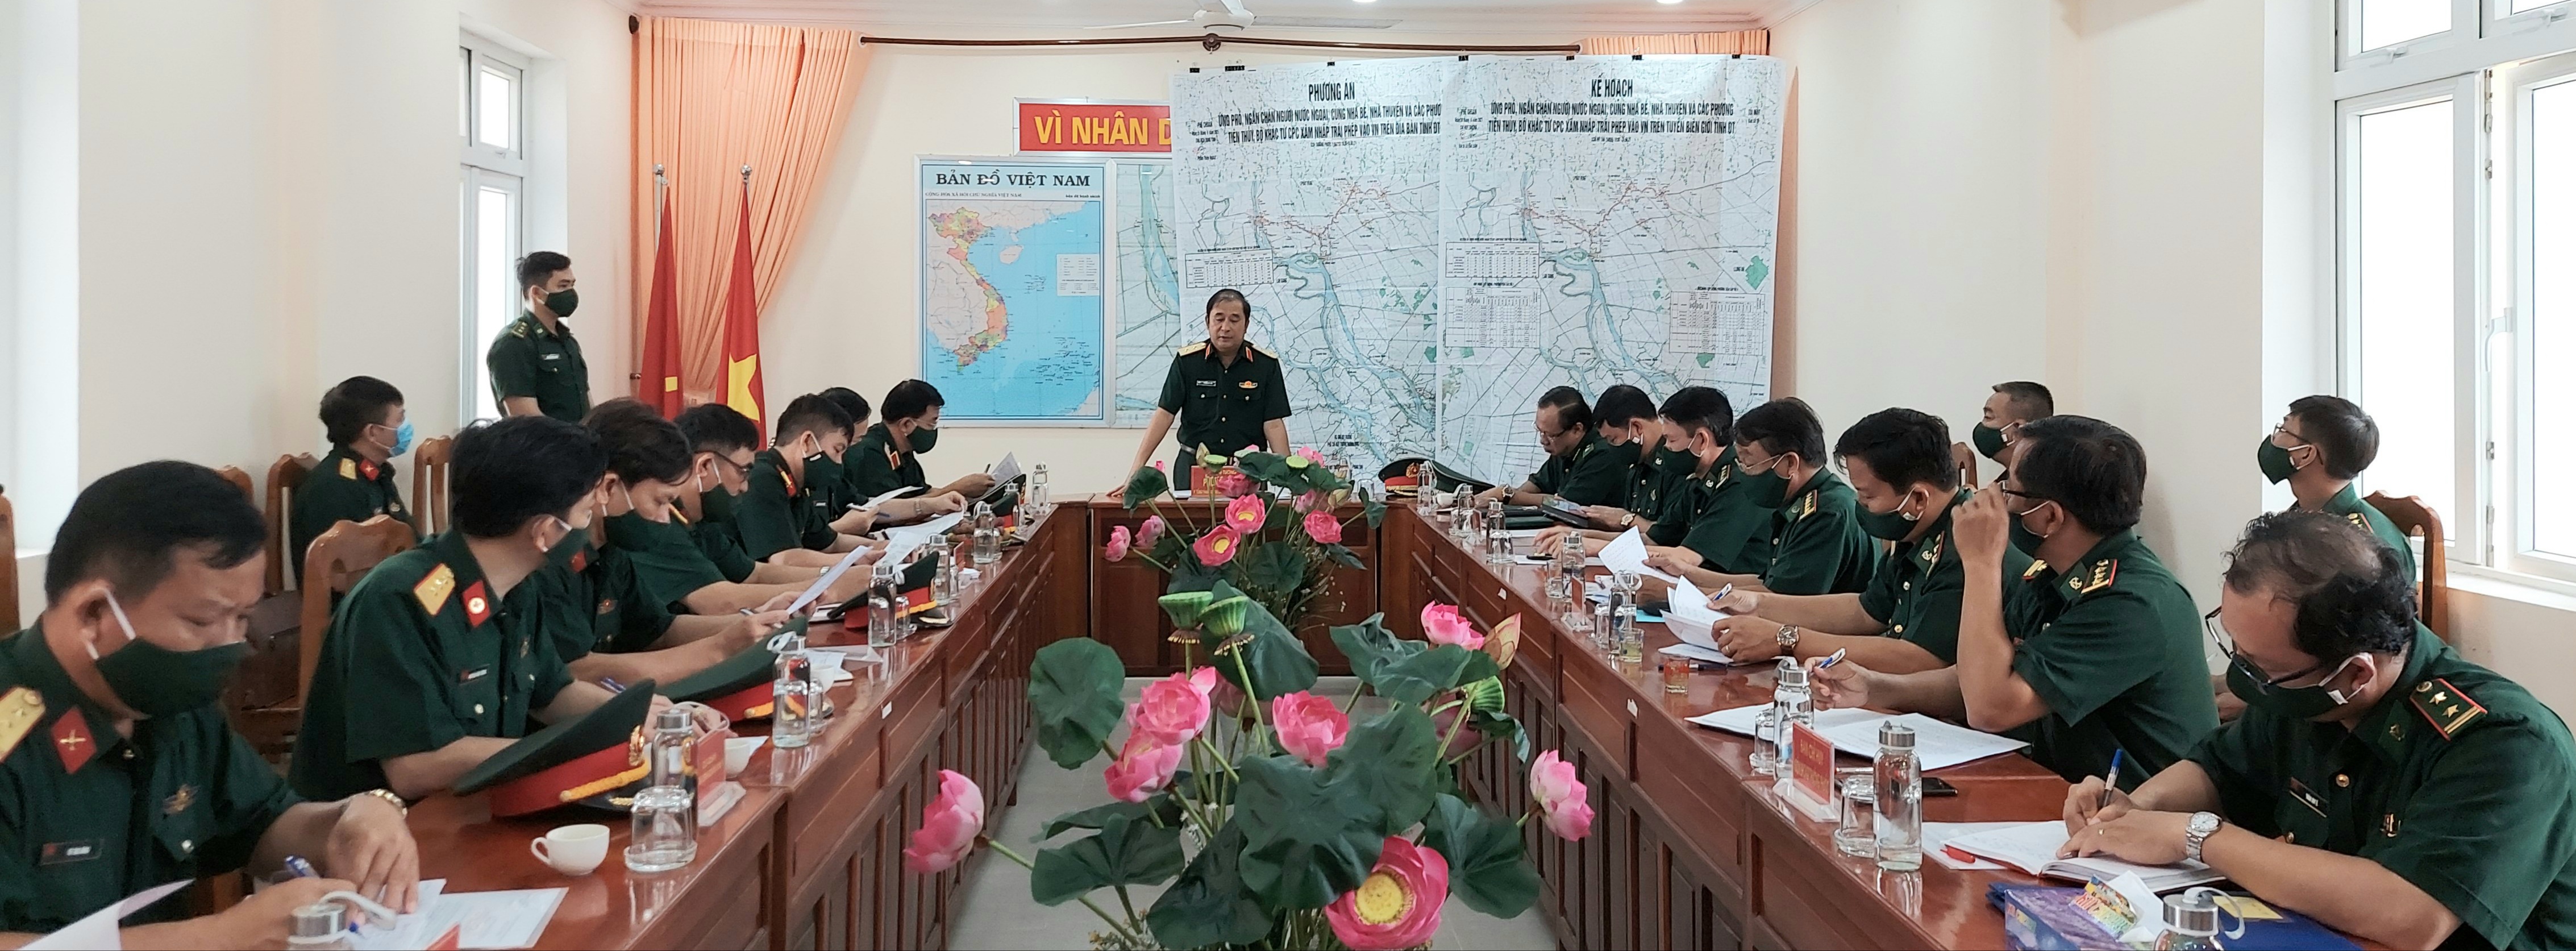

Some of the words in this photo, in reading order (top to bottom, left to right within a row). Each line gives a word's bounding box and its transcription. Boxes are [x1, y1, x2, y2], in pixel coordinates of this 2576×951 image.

[1308, 81, 1341, 102] PHƯƠNG
[1343, 78, 1355, 100] ÁN
[1591, 73, 1602, 98] KẾ
[1604, 79, 1633, 102] HOẠCH
[1218, 112, 1230, 126] ỨNG
[1276, 107, 1293, 123] NGƯỜI
[1295, 106, 1309, 121] NƯỚC
[1405, 102, 1412, 117] VÀ
[1414, 102, 1425, 117] CÁC
[1426, 103, 1442, 117] PHƯƠ
[1491, 100, 1503, 114] ỨNG
[1553, 100, 1570, 115] NGƯỜI
[1572, 100, 1587, 115] NƯỚC
[1688, 100, 1696, 115] VÀ
[1698, 100, 1709, 115] CÁC
[1711, 101, 1734, 116] PHƯƠNG
[1034, 109, 1062, 144] VÌ
[1072, 110, 1148, 145] NHÂN
[1158, 118, 1171, 145] D
[1264, 126, 1279, 141] KHÁC
[1288, 127, 1299, 139] CPC
[1301, 124, 1313, 139] XÂM
[1331, 123, 1343, 138] TRÁI
[1344, 122, 1358, 137] PHÉP
[1359, 122, 1370, 136] VÀO
[1371, 123, 1379, 136] VN
[1380, 121, 1394, 135] TRÊN
[1406, 119, 1418, 134] BÀN
[1528, 118, 1543, 132] KHÁC
[1553, 120, 1564, 132] CPC
[1565, 118, 1579, 132] XÂM
[1597, 118, 1610, 133] TRÁI
[1611, 118, 1626, 133] PHÉP
[1628, 118, 1639, 133] VÀO
[1641, 121, 1648, 133] VN
[1650, 118, 1664, 133] TRÊN
[1666, 117, 1684, 133] TUYẾN
[1686, 118, 1700, 133] BIÊN
[1701, 118, 1712, 134] GIỚI
[936, 169, 971, 185] BẢN
[977, 169, 1000, 185] ĐỒ
[1007, 171, 1047, 188] VIỆT
[1052, 175, 1091, 186] NAM
